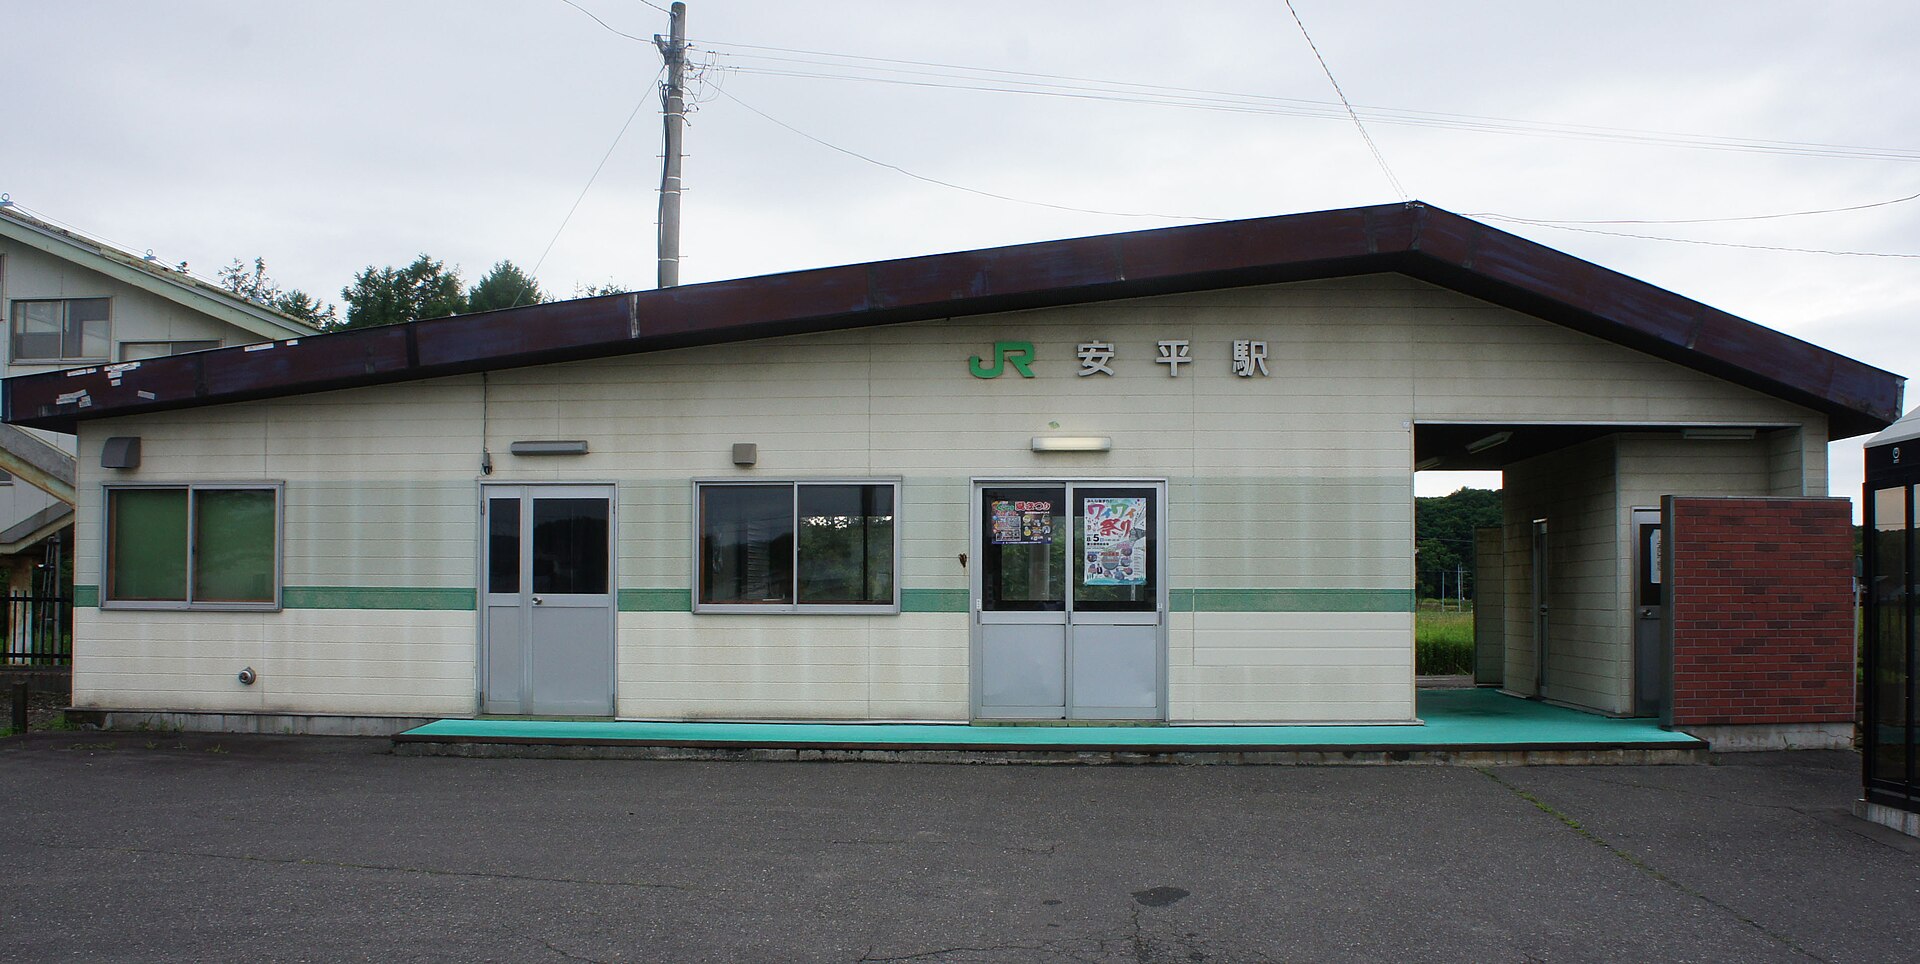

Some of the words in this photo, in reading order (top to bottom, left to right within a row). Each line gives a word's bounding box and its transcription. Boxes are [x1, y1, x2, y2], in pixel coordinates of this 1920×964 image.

[969, 341, 1035, 378] JR
[1077, 339, 1270, 377] 安平駅
[1088, 503, 1136, 520] ワイワイ
[1097, 518, 1132, 538] 祭り
